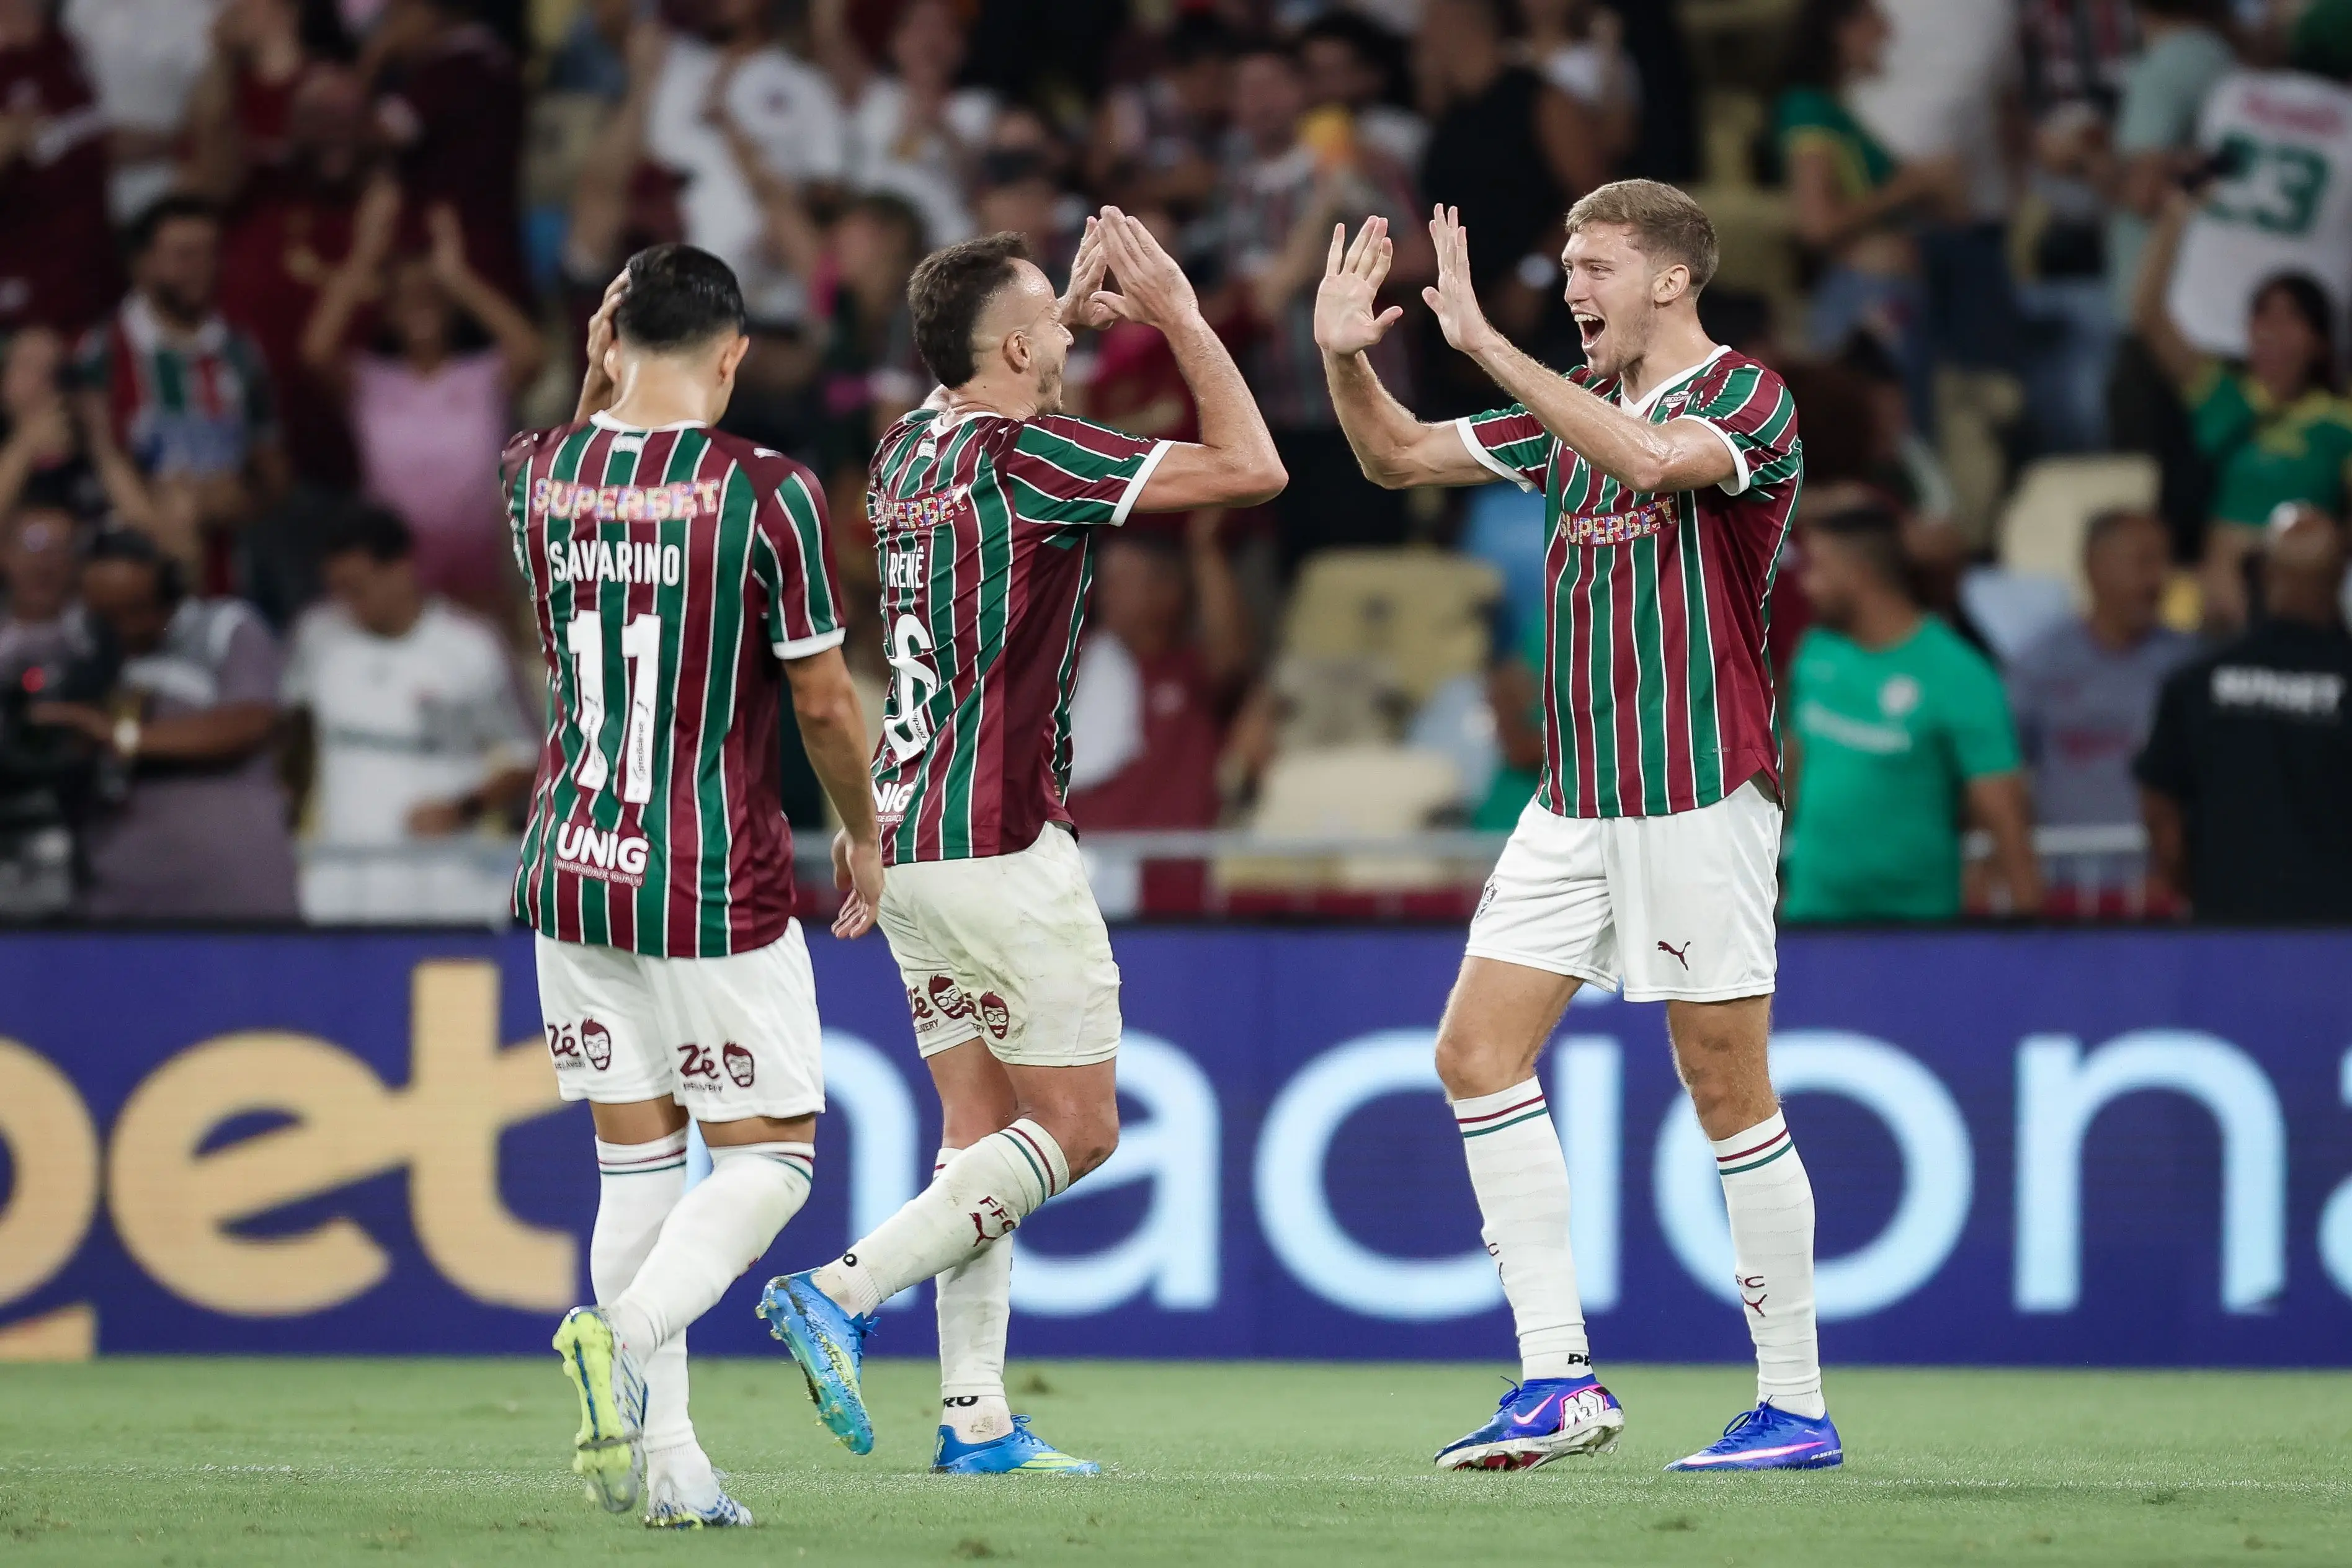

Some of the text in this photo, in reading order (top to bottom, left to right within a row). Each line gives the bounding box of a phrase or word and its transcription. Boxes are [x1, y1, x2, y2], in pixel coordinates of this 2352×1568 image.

[532, 478, 721, 521] SUPERBET
[1559, 496, 1676, 545] SUPERBET
[548, 540, 681, 586] SAVARINO
[889, 547, 924, 589] RENÊ
[567, 610, 661, 805] 11
[871, 780, 915, 813] NIG
[556, 821, 649, 875] UNIG
[547, 1023, 580, 1057] Zé
[677, 1045, 720, 1079] Zé
